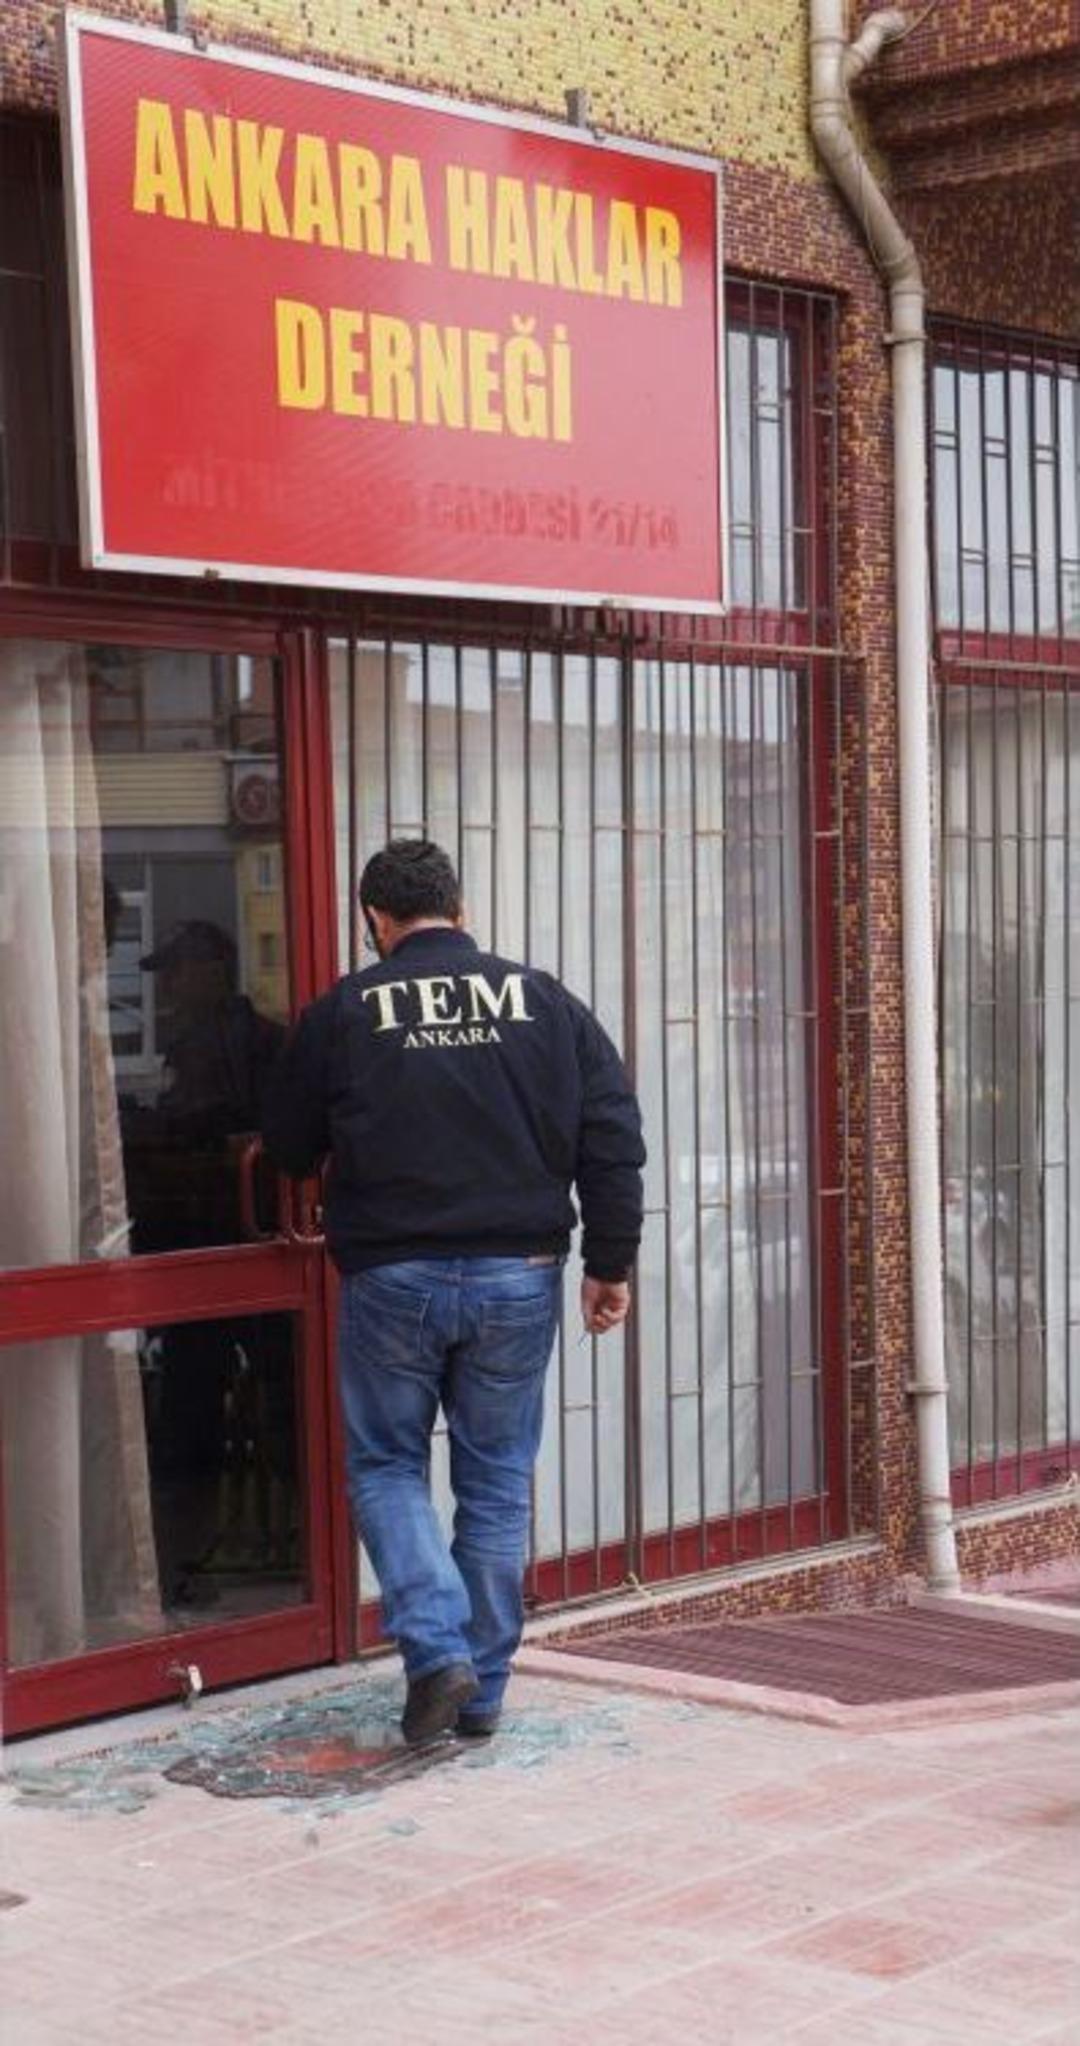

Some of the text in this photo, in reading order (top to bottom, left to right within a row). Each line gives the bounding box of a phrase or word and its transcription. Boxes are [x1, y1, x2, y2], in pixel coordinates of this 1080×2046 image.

[133, 99, 683, 307] ANKARA HAKLAR
[275, 298, 573, 442] DERNEĞİ
[362, 973, 535, 1032] TEM
[403, 1025, 502, 1049] ANKARA
